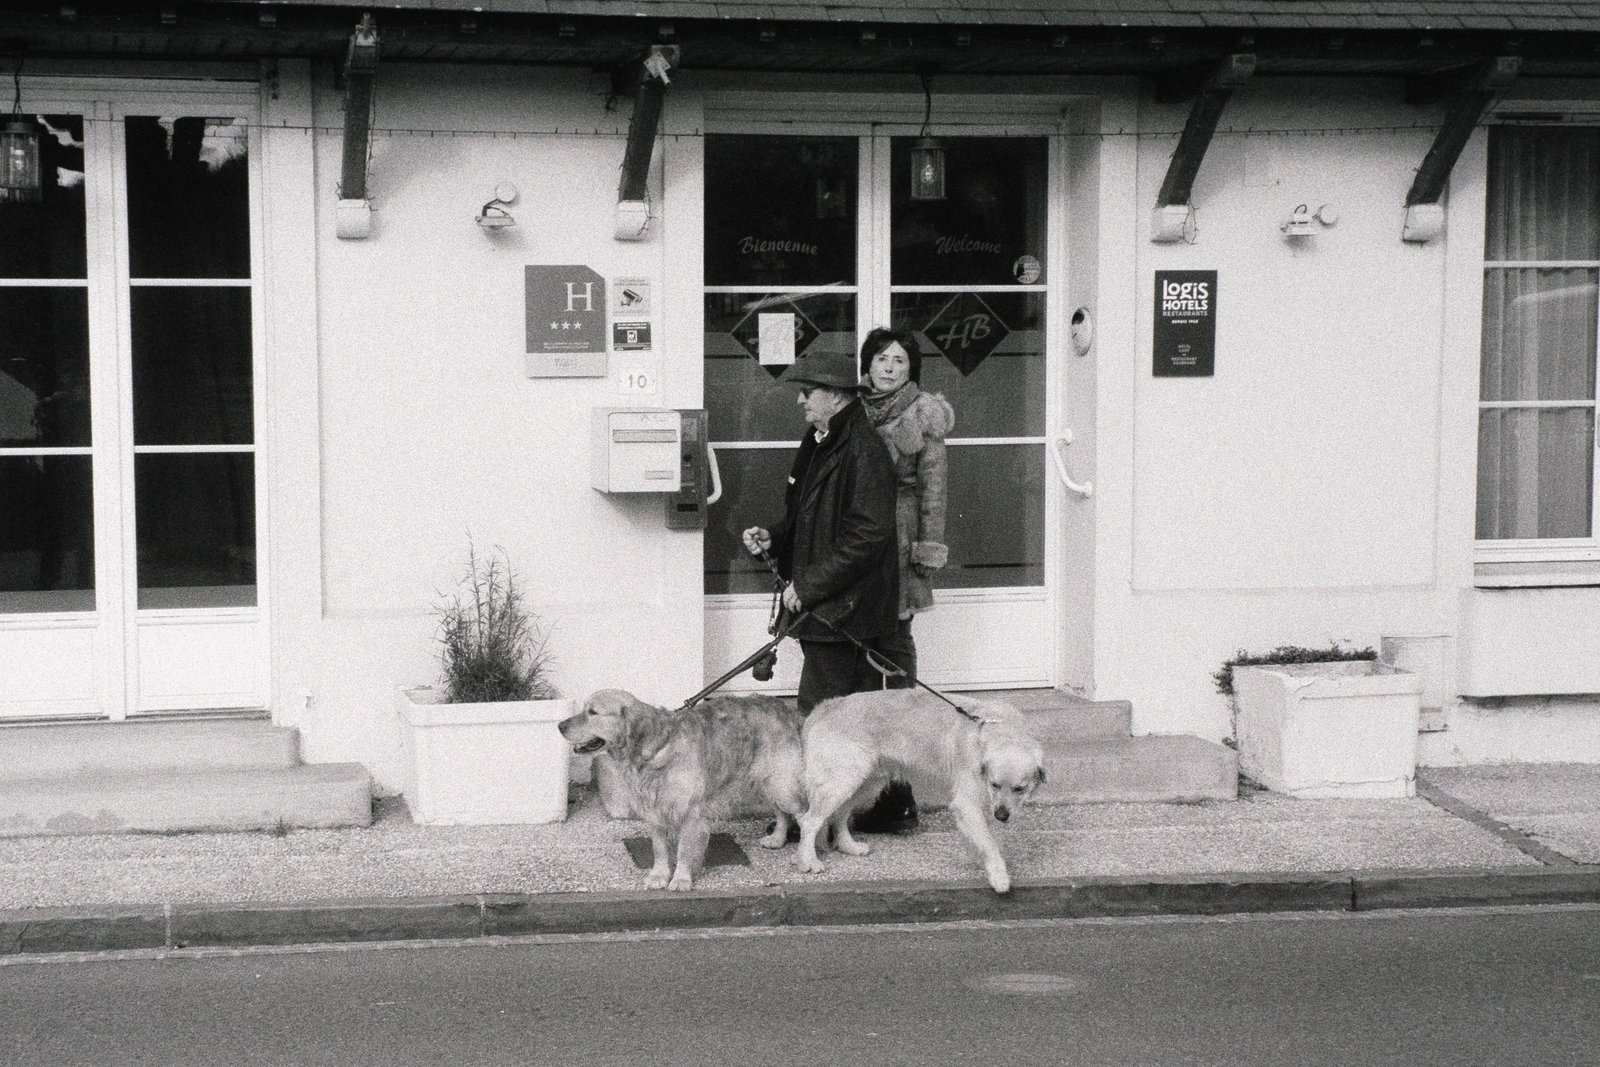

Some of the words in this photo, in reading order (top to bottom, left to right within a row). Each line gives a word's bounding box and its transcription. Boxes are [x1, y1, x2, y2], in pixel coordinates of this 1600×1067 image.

[737, 235, 818, 256] Bienvenue
[935, 234, 1002, 255] Welcome
[563, 282, 595, 312] H
[1162, 300, 1208, 310] HOTELS
[936, 313, 992, 350] HB
[628, 375, 648, 389] 10
